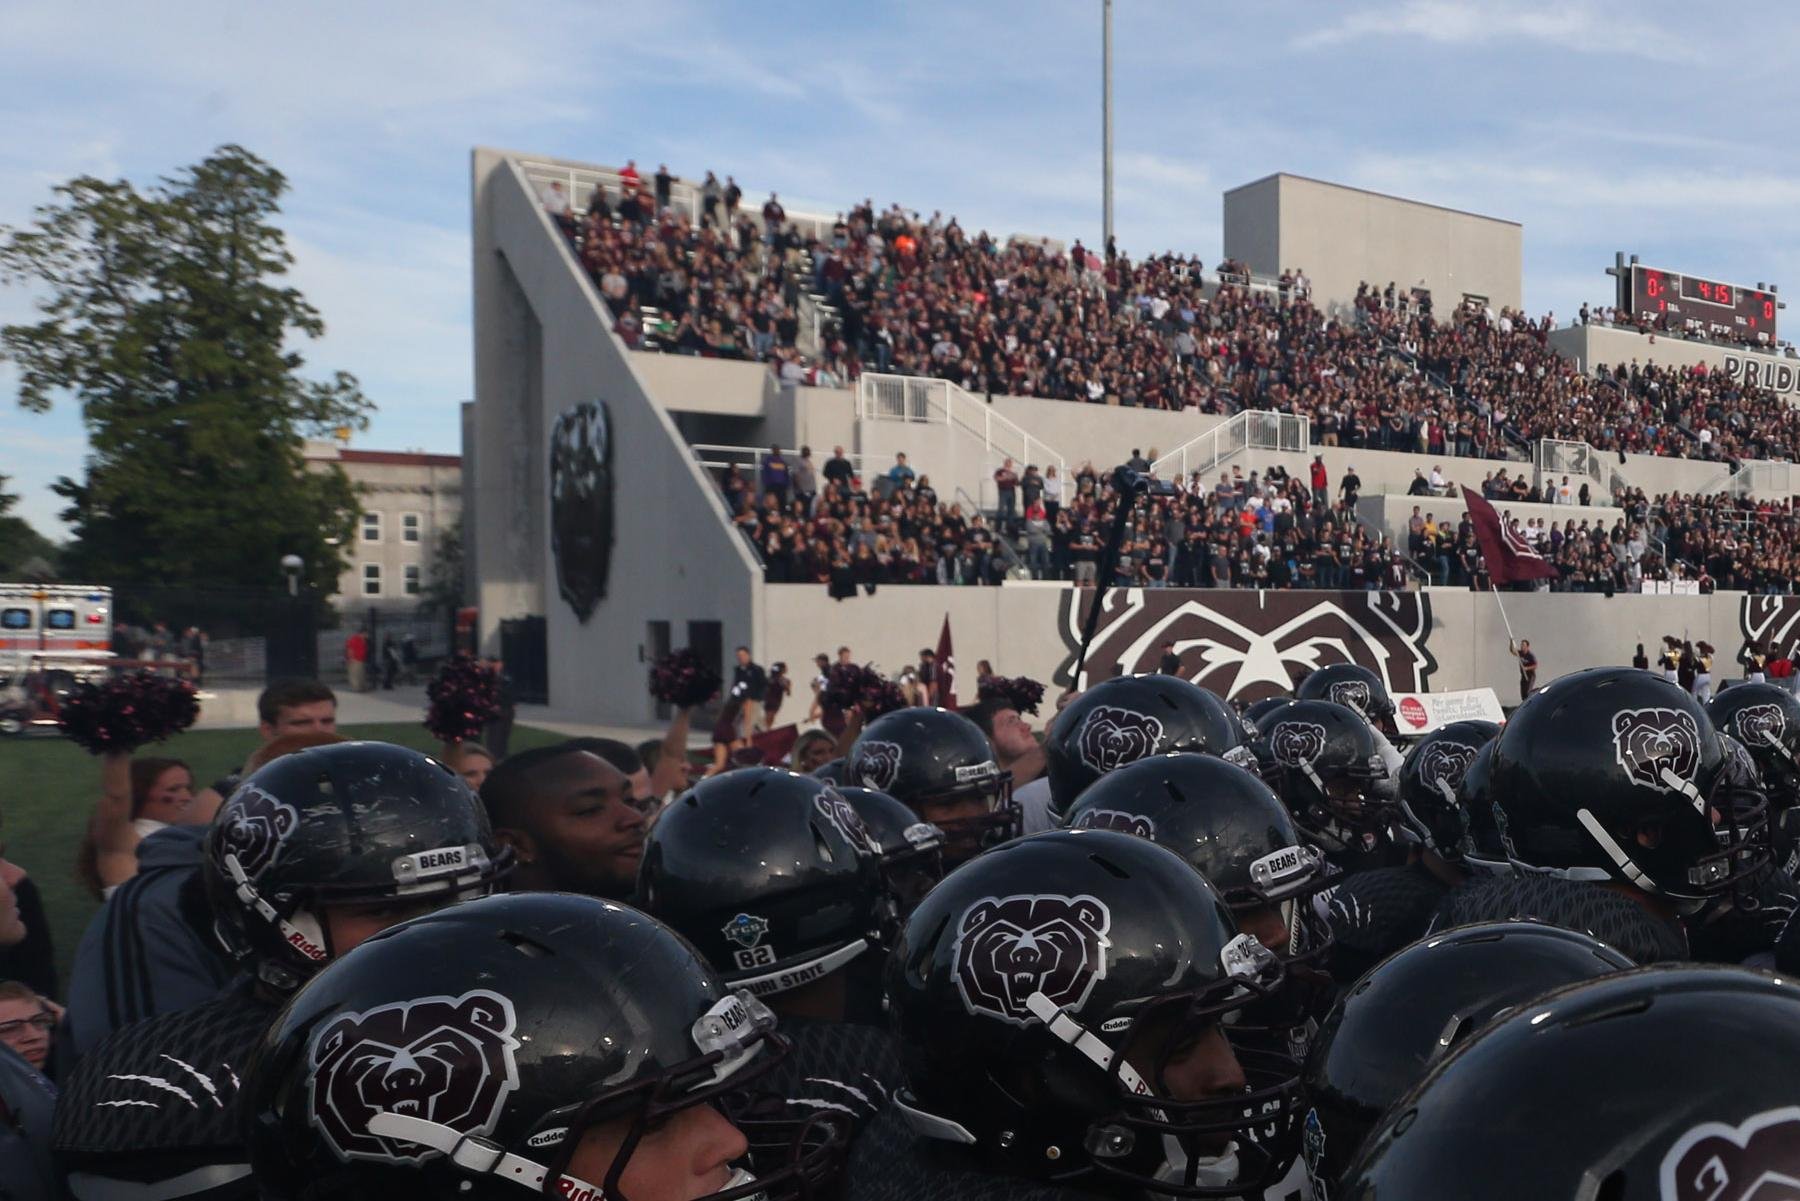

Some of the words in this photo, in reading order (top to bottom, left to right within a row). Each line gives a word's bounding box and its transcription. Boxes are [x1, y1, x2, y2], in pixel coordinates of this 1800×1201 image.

[1764, 300, 1773, 320] 0
[419, 851, 462, 869] BEARS
[1268, 852, 1298, 874] BEARS
[738, 948, 772, 969] 82
[779, 961, 826, 989] STATE
